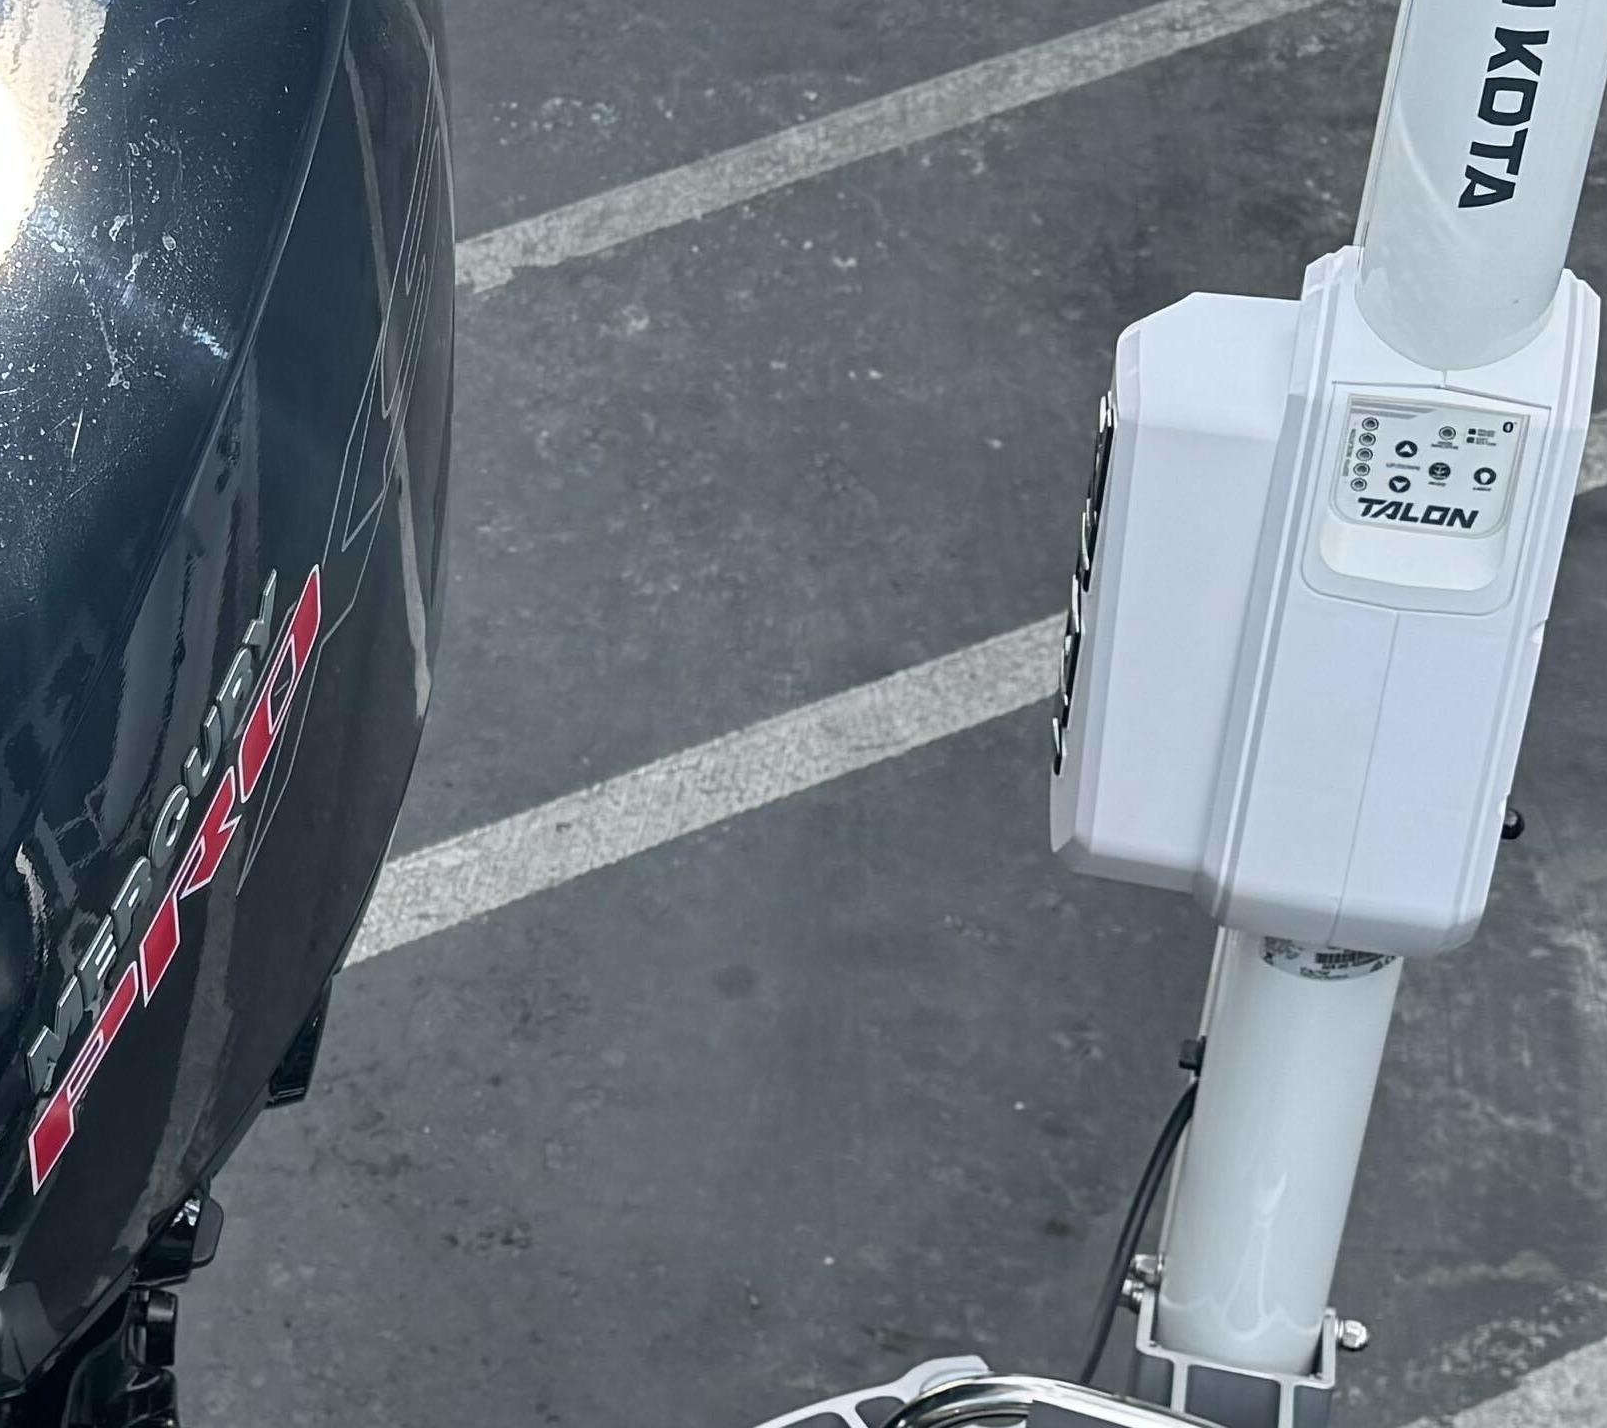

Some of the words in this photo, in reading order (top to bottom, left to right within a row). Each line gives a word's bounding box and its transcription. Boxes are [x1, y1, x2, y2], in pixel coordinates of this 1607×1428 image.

[1458, 27, 1550, 209] KOTA
[1358, 497, 1479, 529] TALON
[27, 569, 277, 1094] MERCURY
[29, 564, 321, 1196] PRO
